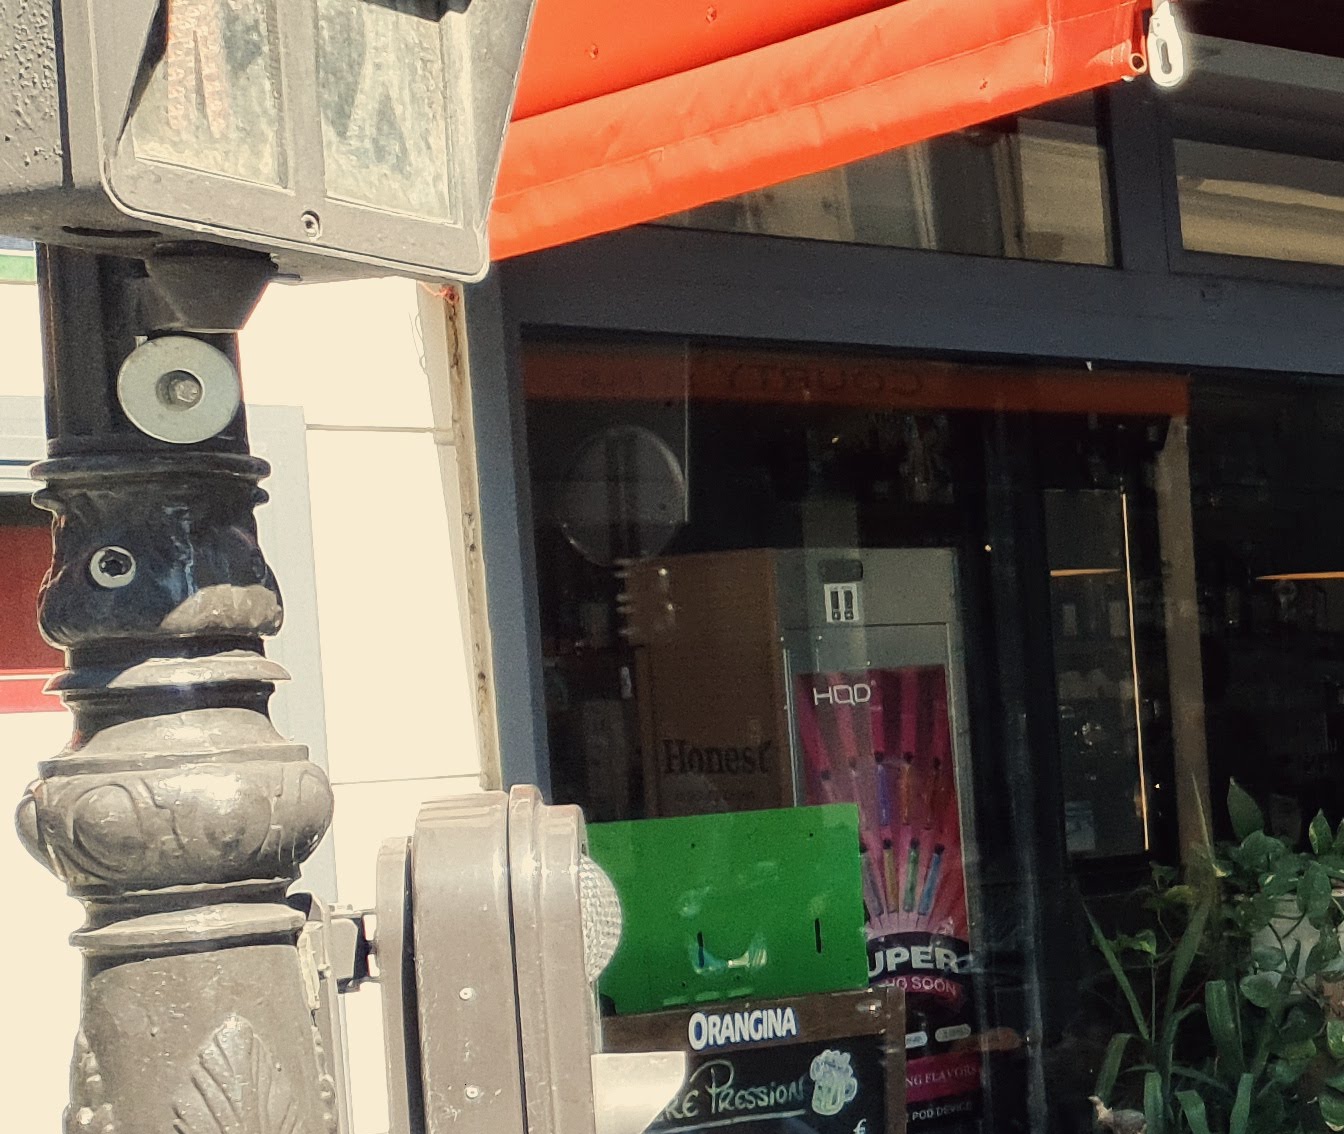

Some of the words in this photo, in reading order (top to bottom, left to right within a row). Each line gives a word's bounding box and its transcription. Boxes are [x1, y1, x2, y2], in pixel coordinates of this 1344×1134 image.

[812, 683, 872, 707] HQD
[661, 739, 776, 778] Honest
[868, 945, 959, 979] UPER
[911, 977, 958, 998] SOON
[688, 1006, 798, 1051] ORANGINA
